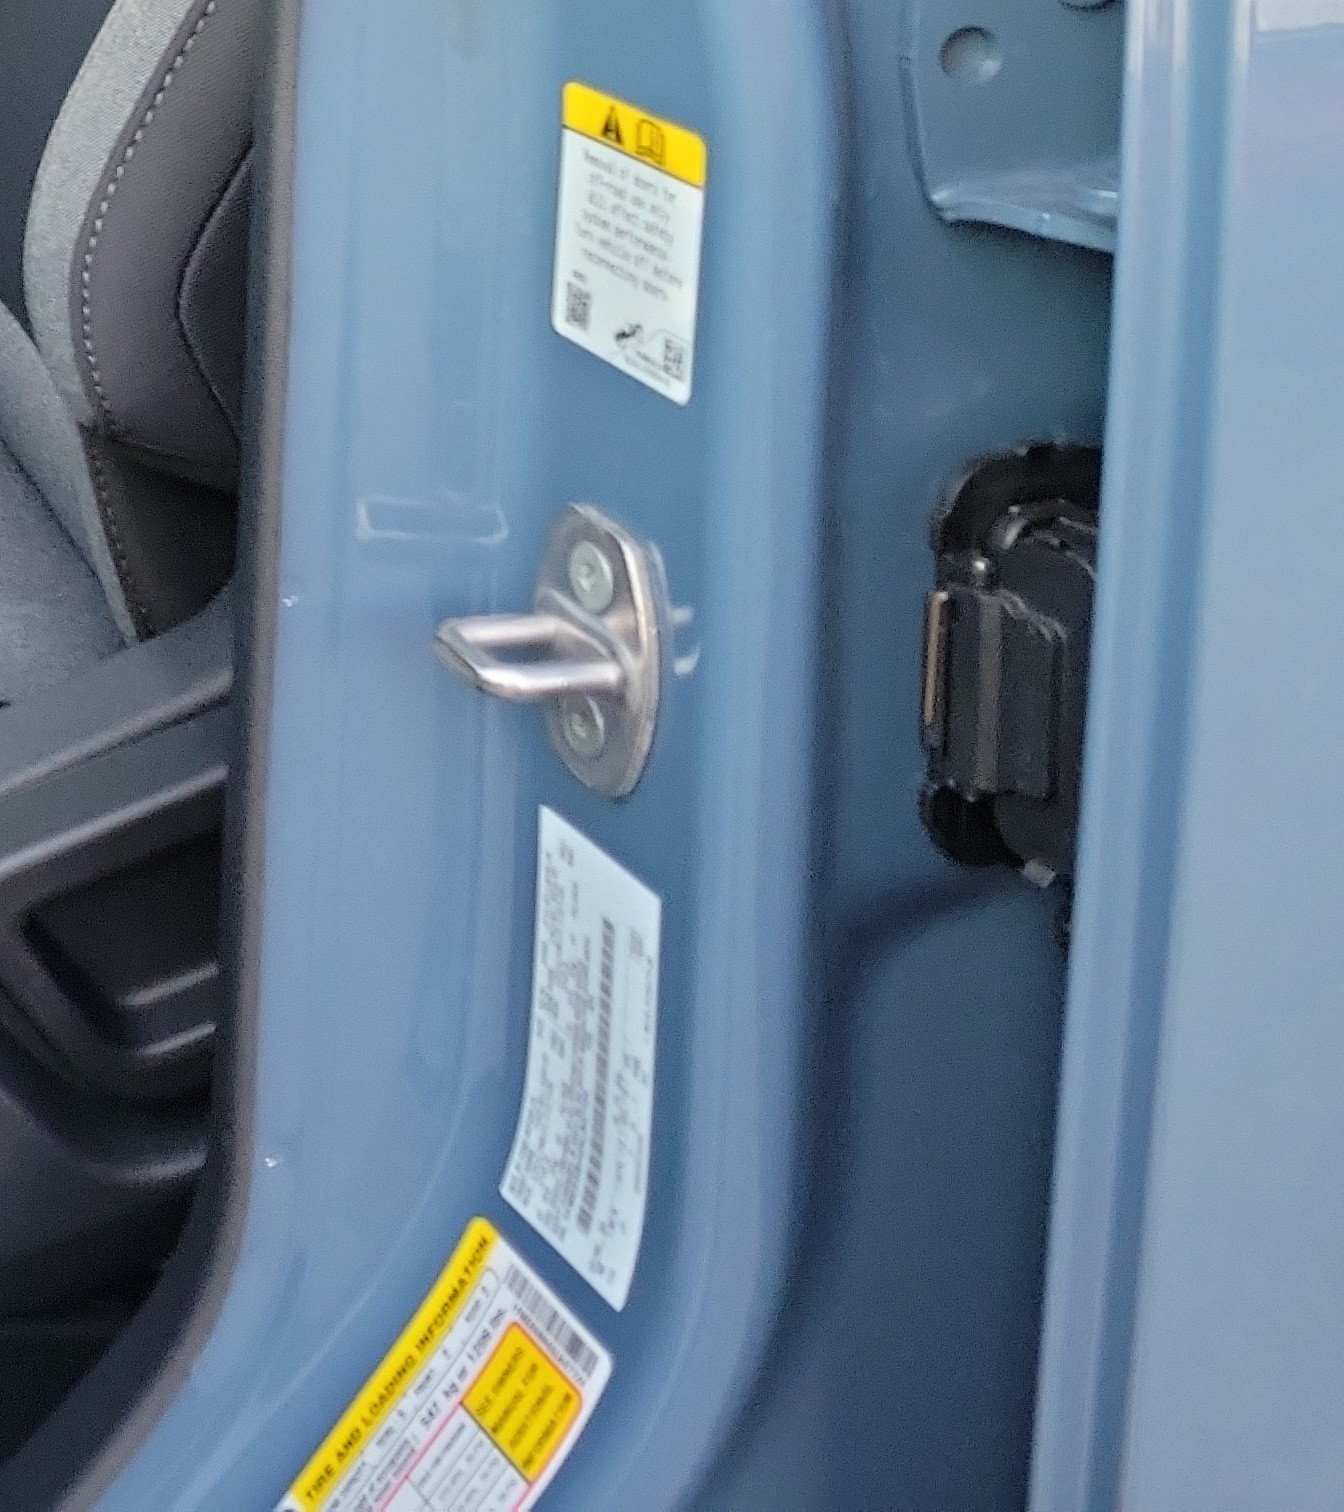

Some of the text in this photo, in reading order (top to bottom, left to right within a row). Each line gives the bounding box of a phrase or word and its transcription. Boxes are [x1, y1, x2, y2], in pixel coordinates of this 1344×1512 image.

[305, 1463, 335, 1500] TIRE
[335, 1430, 362, 1463] AND
[360, 1354, 417, 1428] LOADING
[417, 1235, 490, 1354] INFORMATION
